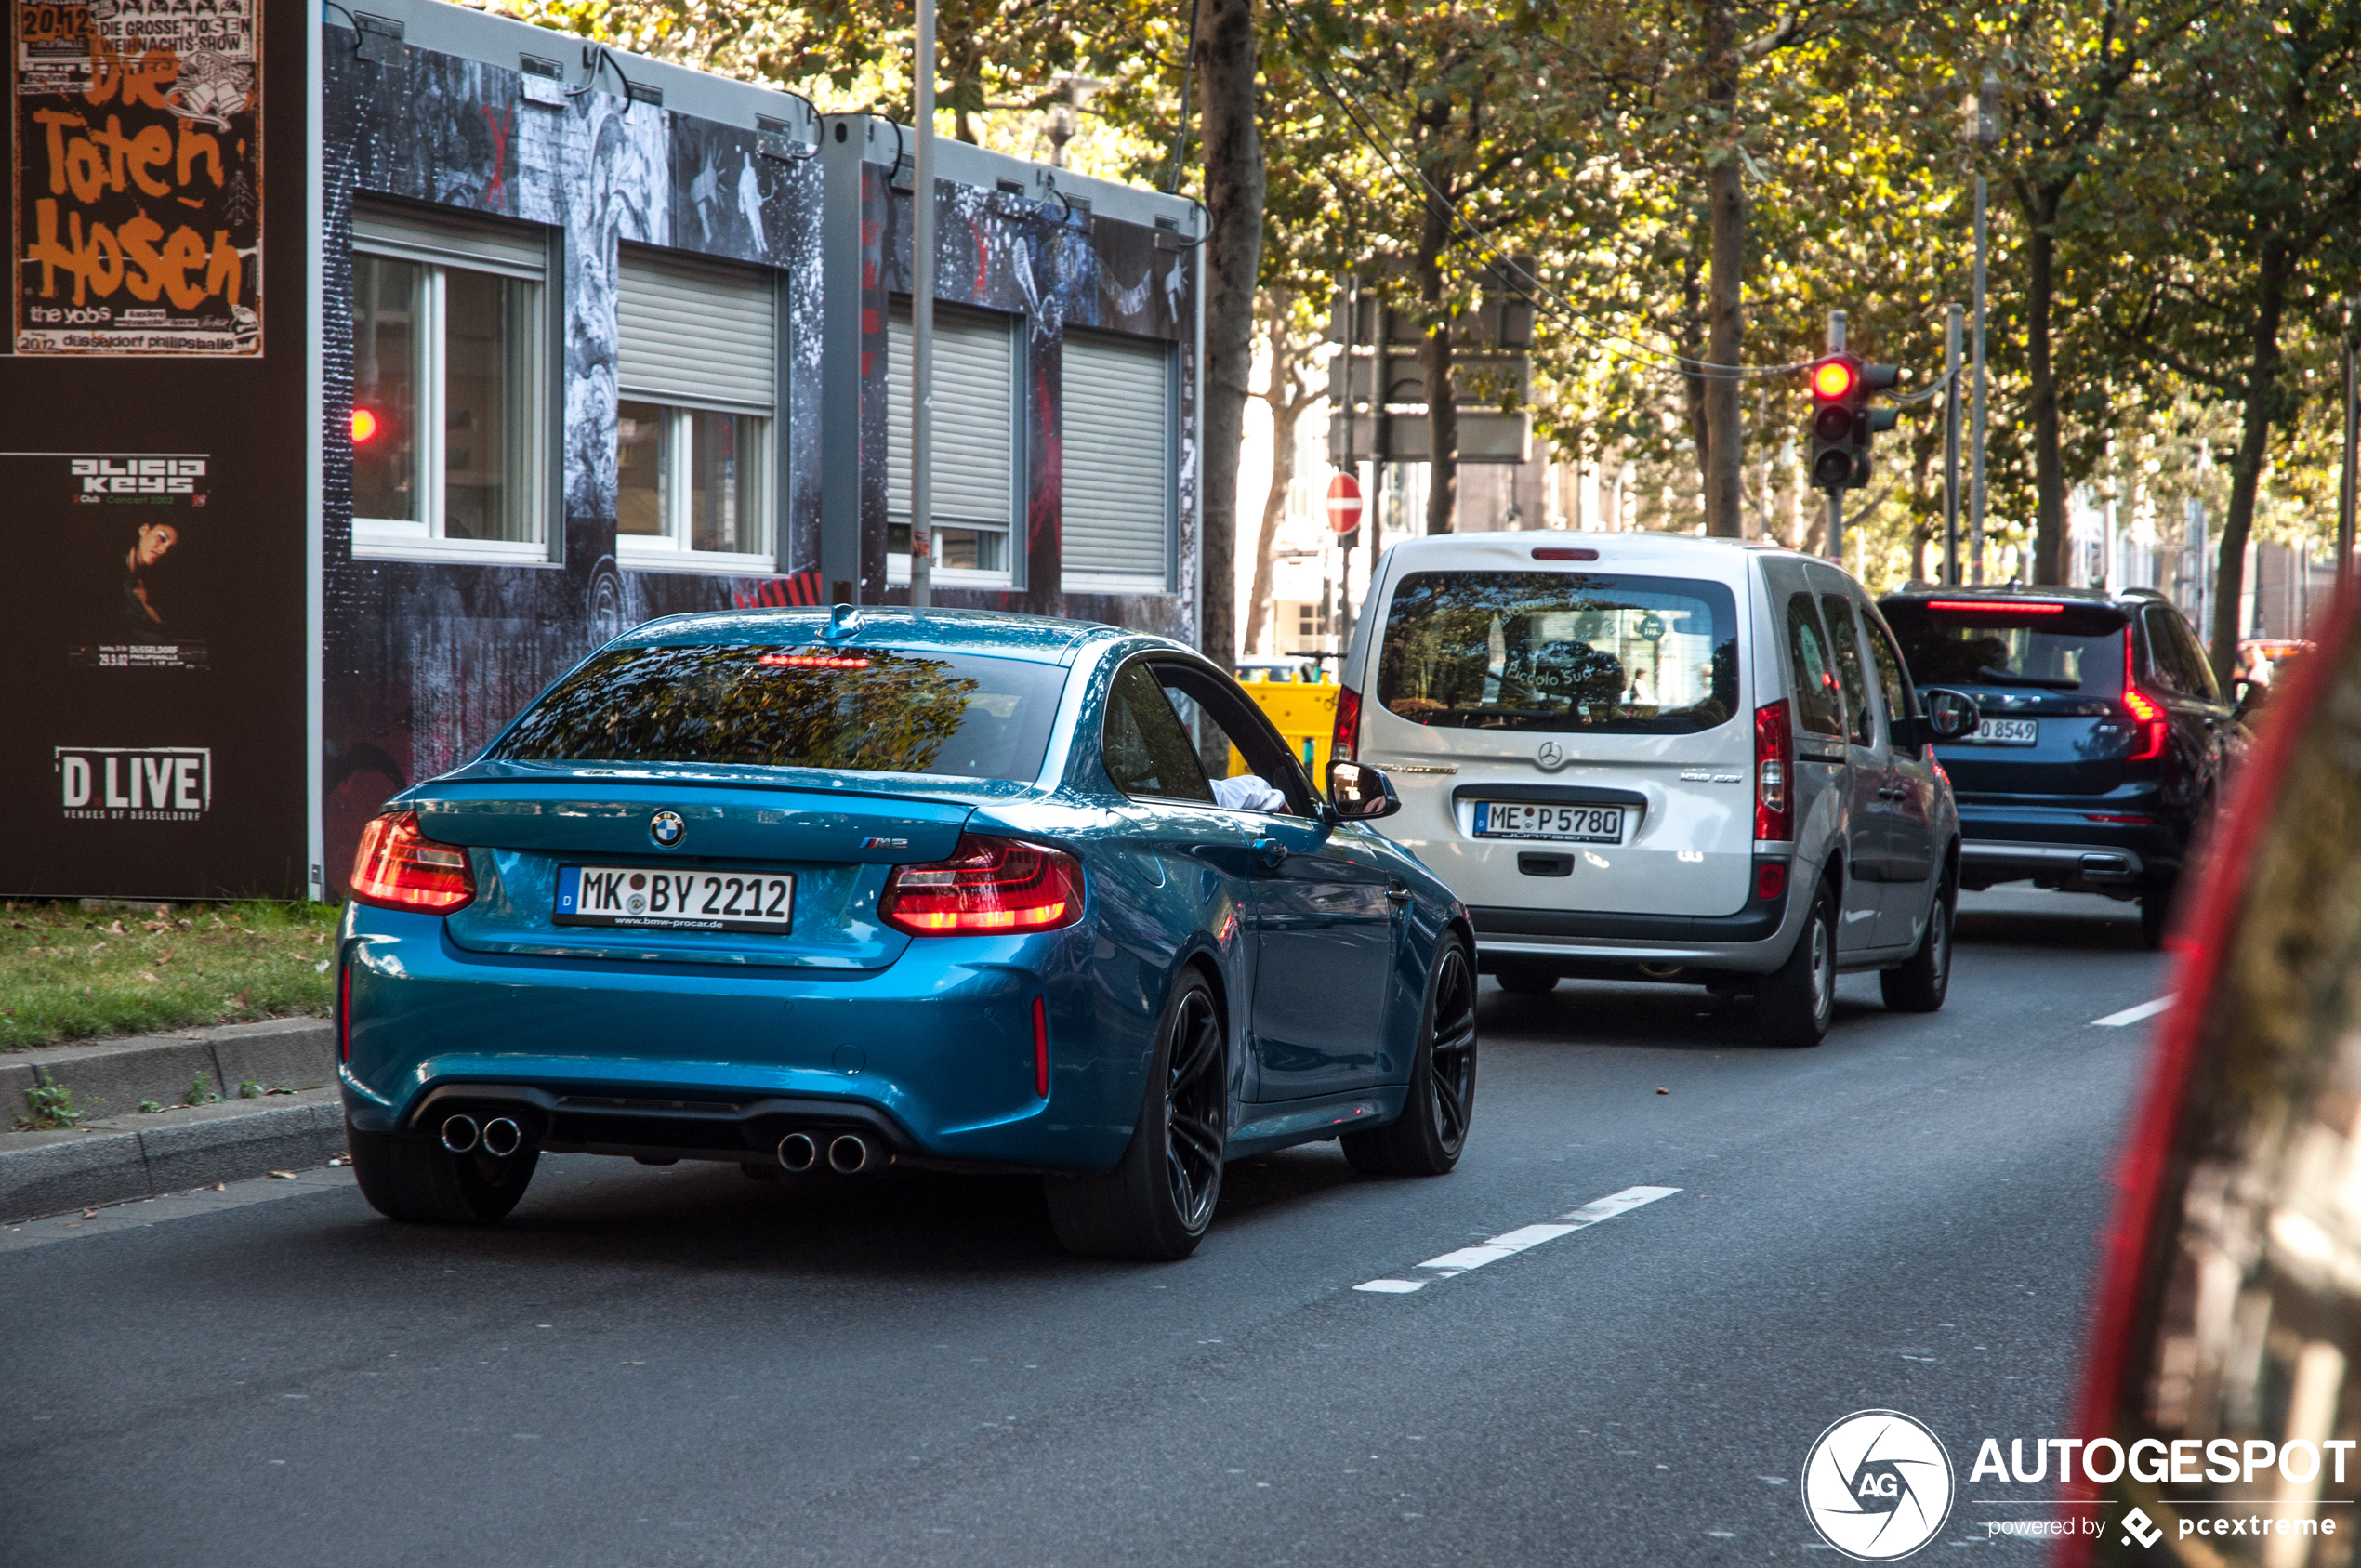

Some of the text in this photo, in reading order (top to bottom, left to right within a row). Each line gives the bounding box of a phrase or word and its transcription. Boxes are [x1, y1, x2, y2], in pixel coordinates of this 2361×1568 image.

[99, 17, 250, 37] DIE GROSSE HOSEN
[28, 198, 242, 310] Hosen
[30, 306, 112, 324] the yobs
[62, 334, 144, 348] düsseldorf
[147, 336, 234, 350] philipshalle
[1507, 662, 1559, 686] Piccolo
[1994, 721, 2036, 740] 8549
[63, 810, 106, 820] VENUES
[112, 810, 125, 820] OF
[1490, 806, 1521, 830] ME
[1538, 808, 1553, 831] P
[1558, 809, 1618, 834] 5780
[581, 872, 626, 910] MK
[649, 874, 694, 913] BY
[701, 876, 787, 917] 2212
[614, 916, 724, 929] www.bmw-procar.de
